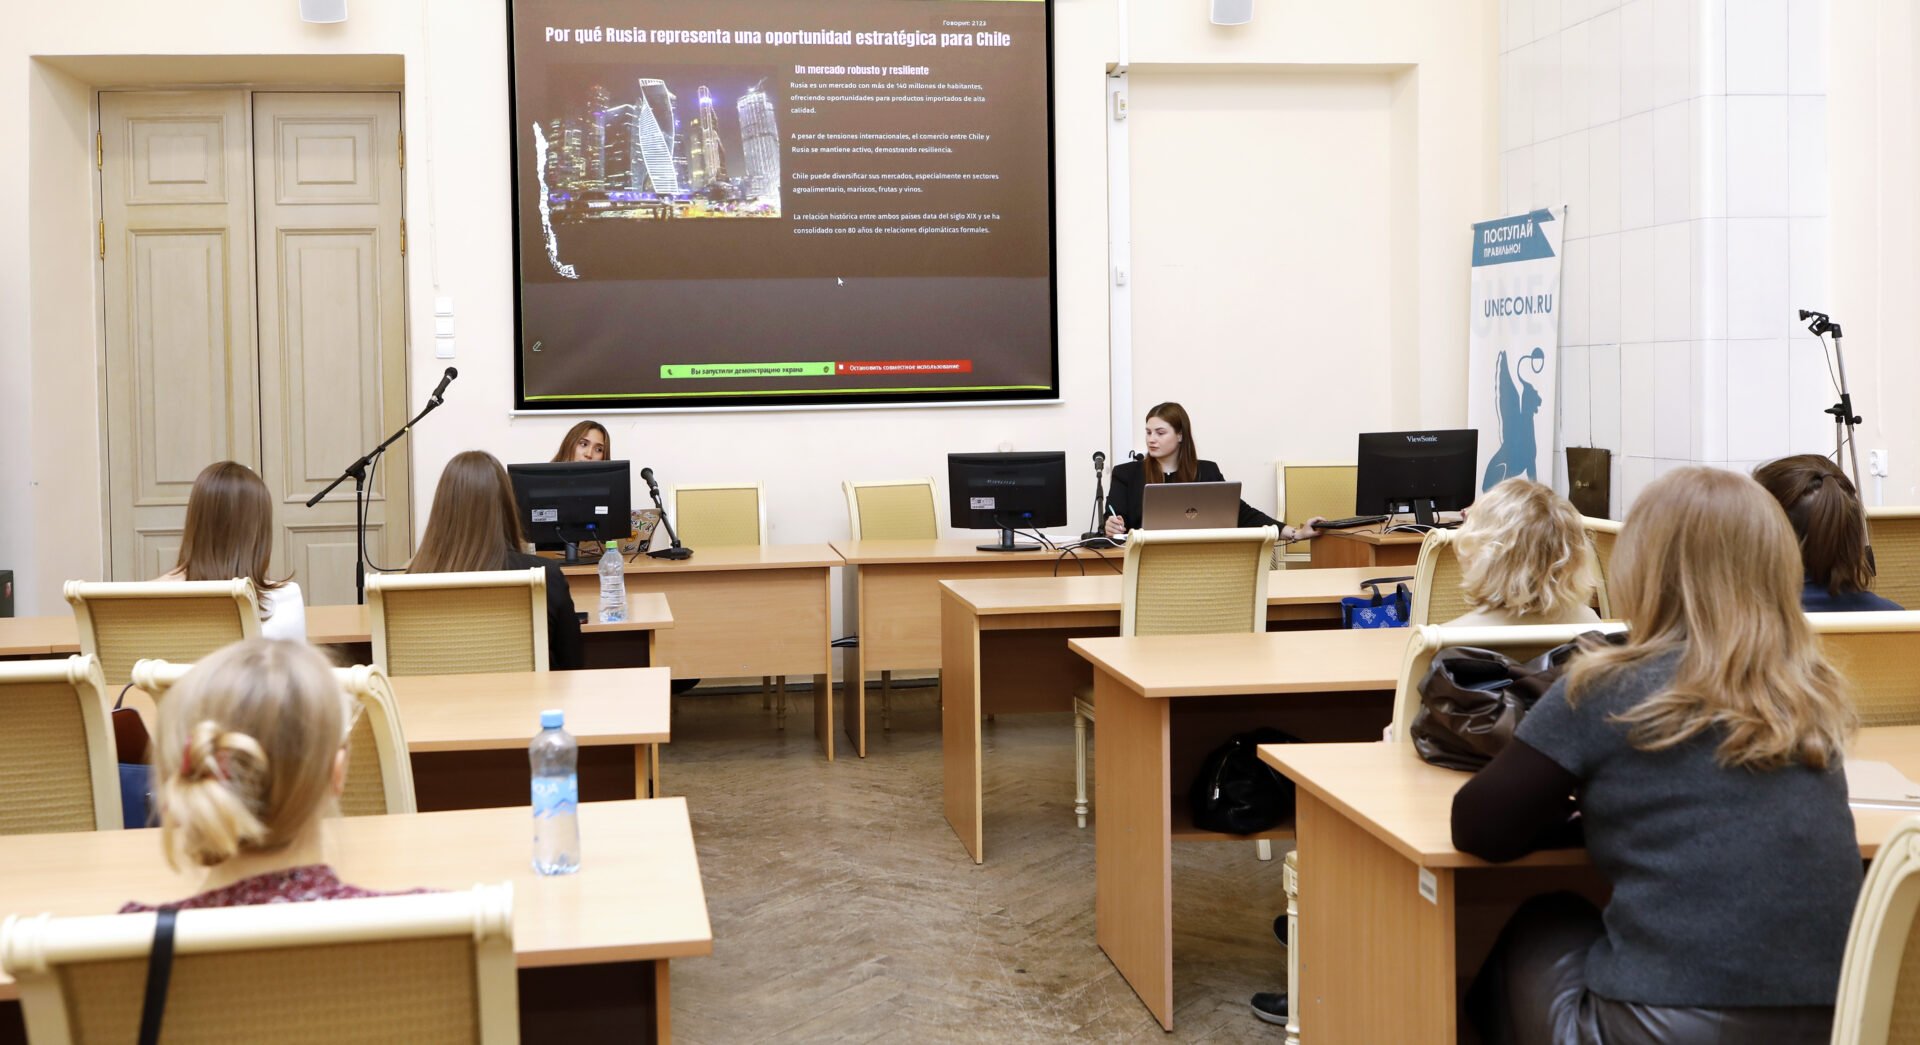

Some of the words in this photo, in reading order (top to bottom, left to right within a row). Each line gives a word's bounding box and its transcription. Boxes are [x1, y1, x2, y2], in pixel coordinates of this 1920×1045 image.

[545, 26, 571, 42] Por
[574, 25, 603, 44] qué
[606, 26, 647, 43] Rusia
[650, 28, 731, 45] representa
[734, 30, 762, 44] una
[765, 28, 852, 46] oportunidad
[855, 29, 937, 47] estratégica
[940, 33, 973, 47] para
[976, 31, 1011, 47] Chile
[794, 64, 806, 74] Un
[807, 65, 846, 75] mercado
[847, 65, 881, 75] robusto
[881, 66, 888, 76] y
[888, 64, 930, 76] resiliente
[826, 94, 875, 102] oportunidades
[925, 95, 963, 103] importados
[859, 132, 911, 140] internacionales,
[810, 172, 831, 181] puede
[880, 172, 914, 180] mercados,
[914, 172, 962, 181] especialmente
[792, 186, 846, 194] agroalimentario,
[949, 212, 966, 221] siglo
[793, 226, 834, 234] consolidado
[918, 226, 960, 235] diplomáticas
[1484, 219, 1533, 244] ПОСТУПАЙ
[1483, 243, 1521, 258] ПРАВИЛЬНО!
[1484, 294, 1552, 318] UNECON.RU
[735, 367, 780, 375] демонстрацию
